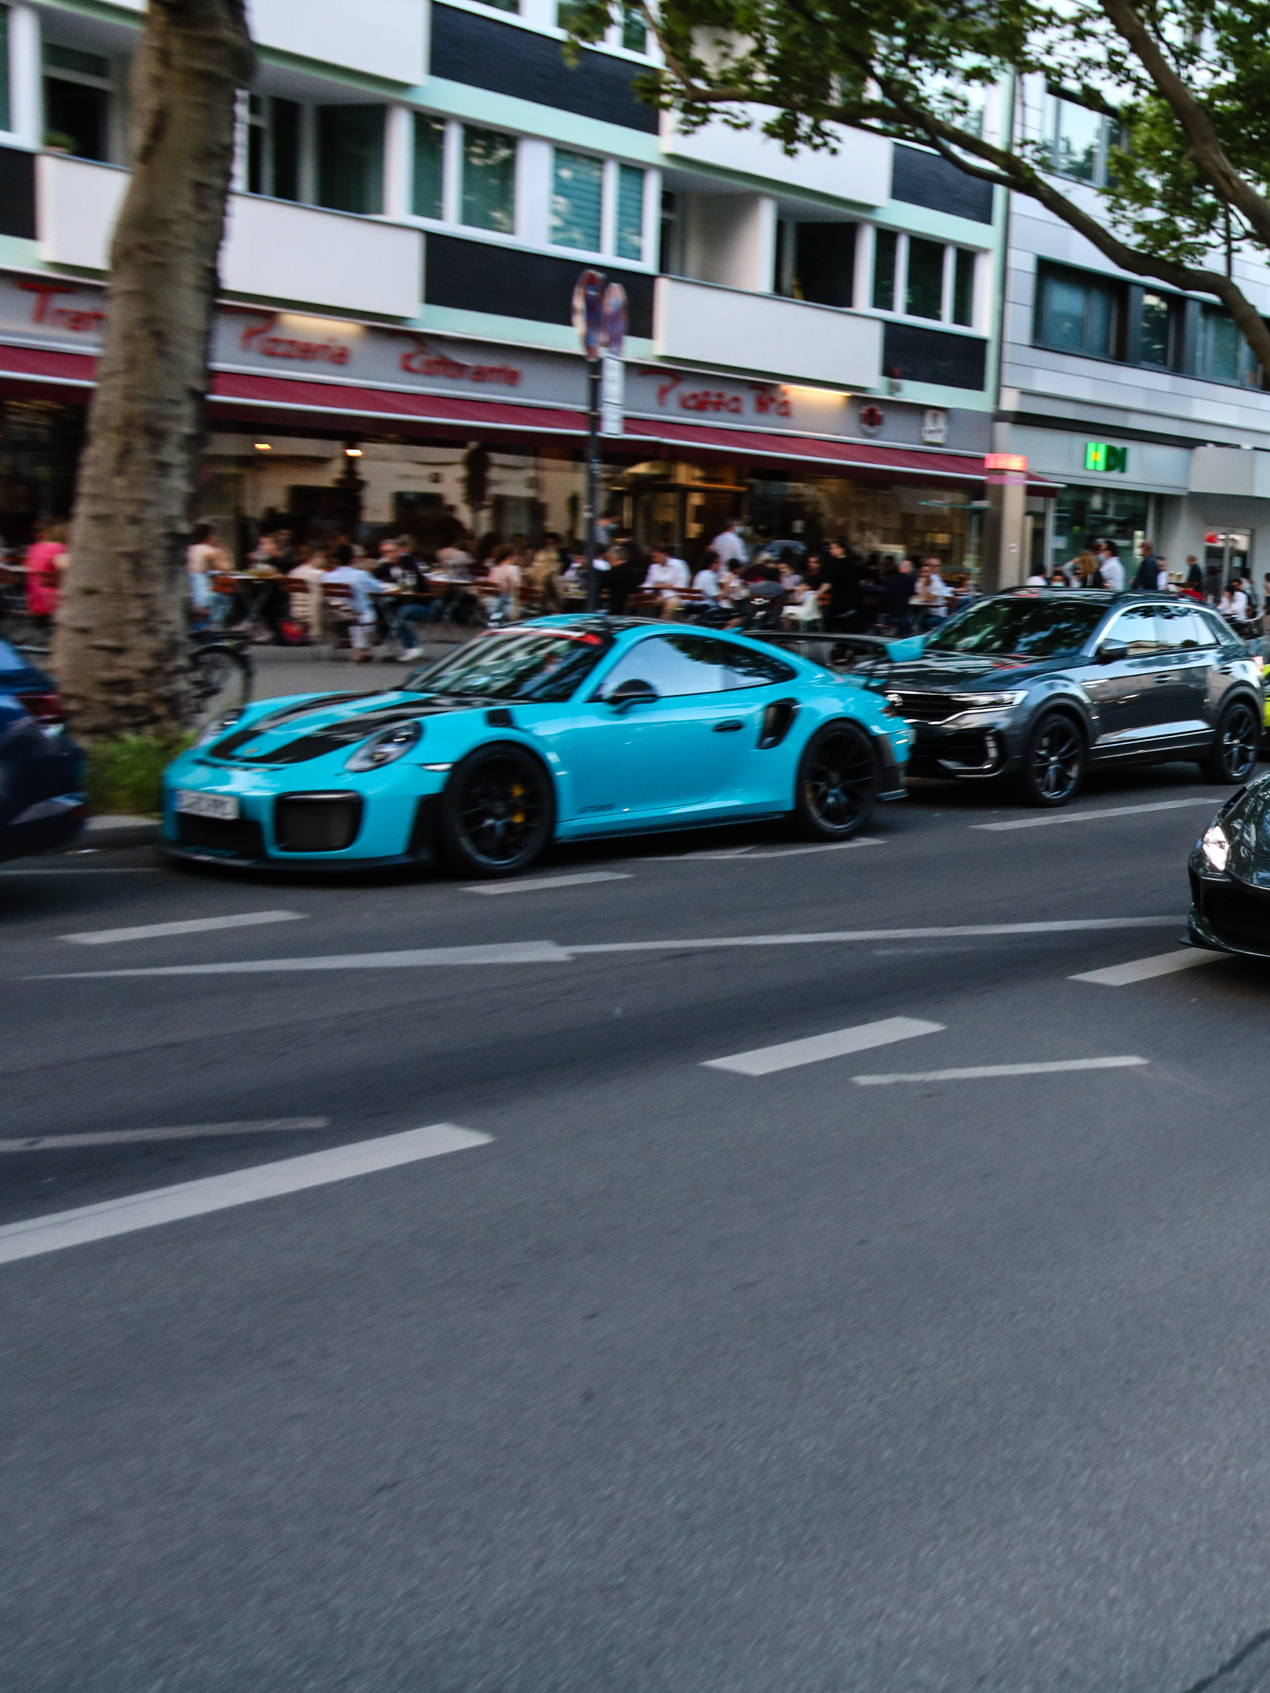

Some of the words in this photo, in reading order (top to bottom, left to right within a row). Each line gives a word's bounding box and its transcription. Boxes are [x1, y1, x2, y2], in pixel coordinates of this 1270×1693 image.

[223, 307, 351, 364] Pizzeria
[641, 369, 743, 413] Piazza
[1086, 442, 1127, 473] HDI
